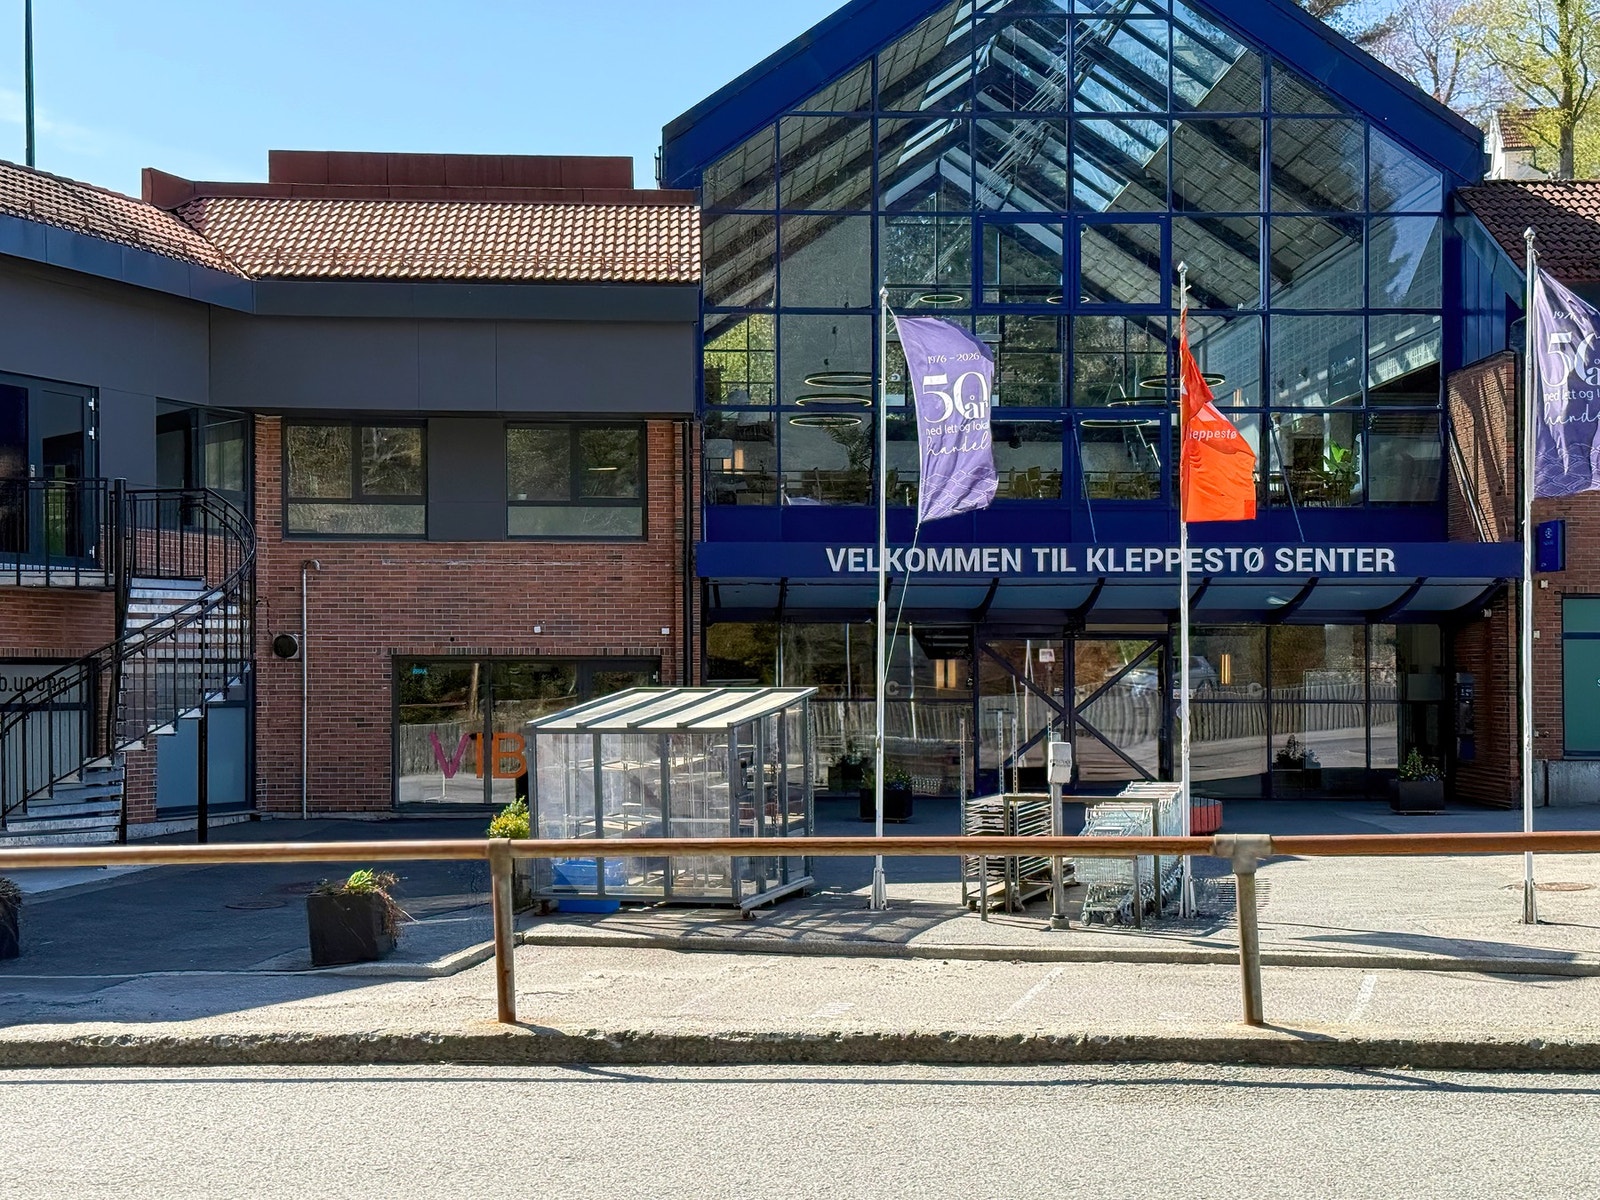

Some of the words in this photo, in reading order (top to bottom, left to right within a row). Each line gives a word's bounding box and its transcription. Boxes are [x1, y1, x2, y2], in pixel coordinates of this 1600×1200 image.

[928, 355, 947, 363] 1976
[956, 352, 980, 361] 2026
[923, 371, 988, 423] 50
[964, 395, 988, 419] år
[1579, 390, 1594, 401] og
[945, 424, 958, 434] lett
[960, 424, 970, 433] og
[926, 430, 989, 456] handel
[826, 547, 1022, 572] VELKOMMEN
[1032, 547, 1077, 572] TIL
[1086, 547, 1265, 573] KLEPPESTØ
[1275, 547, 1396, 572] SENTER
